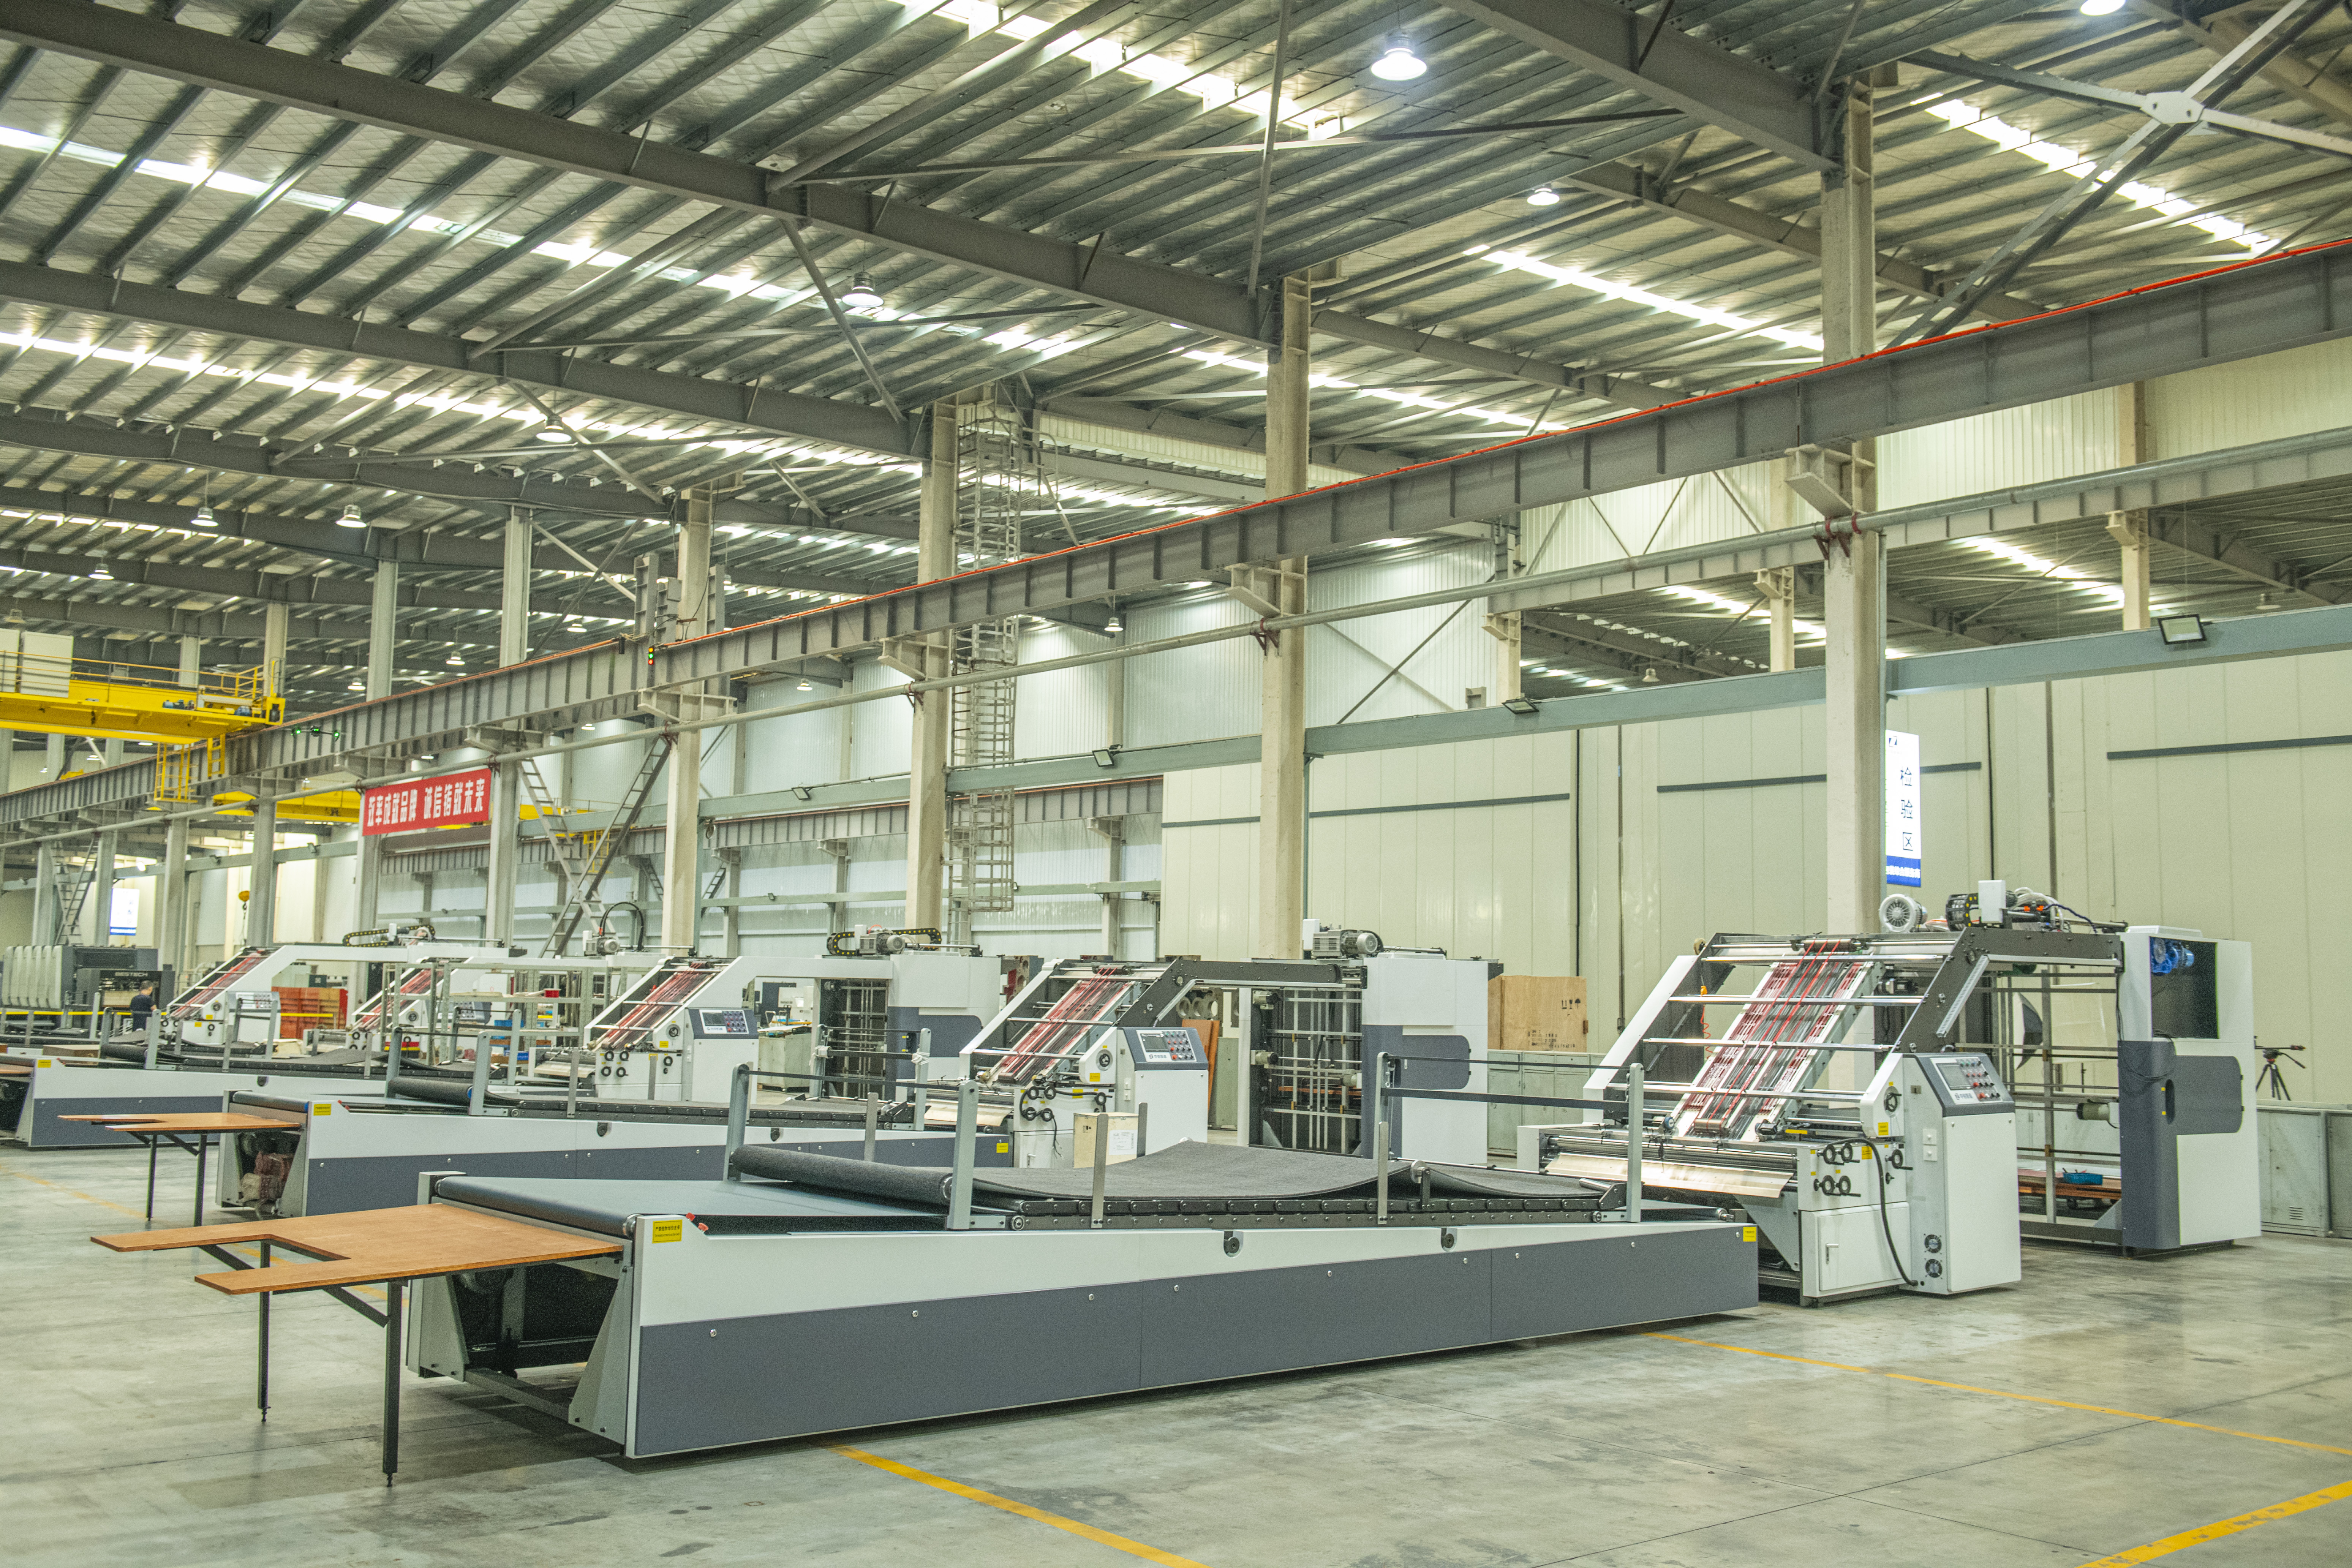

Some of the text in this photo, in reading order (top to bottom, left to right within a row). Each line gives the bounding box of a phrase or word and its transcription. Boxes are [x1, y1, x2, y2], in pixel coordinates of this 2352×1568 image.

[367, 778, 485, 827] 效率成就品牌 诚信铸就未来
[1900, 765, 1913, 851] 检验区
